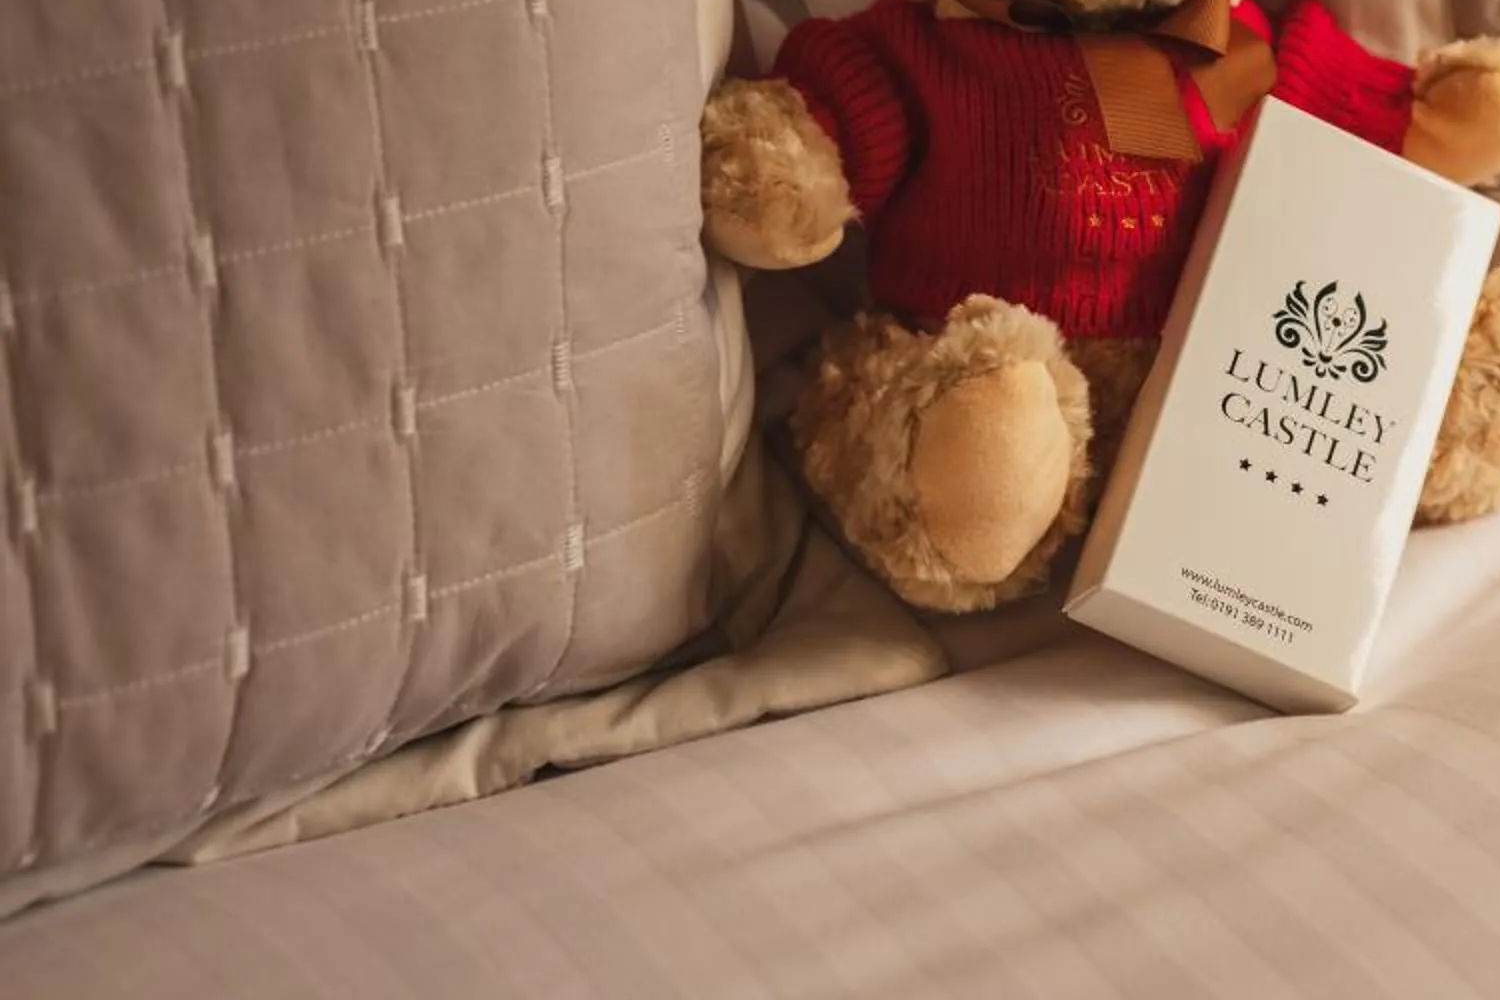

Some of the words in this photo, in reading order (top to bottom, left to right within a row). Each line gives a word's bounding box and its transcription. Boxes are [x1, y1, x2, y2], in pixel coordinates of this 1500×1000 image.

[1224, 348, 1397, 444] LUMLEY
[1220, 391, 1378, 483] CASTLE
[1181, 567, 1313, 632] www.lumleycastle.com
[1241, 611, 1265, 631] 389
[1267, 623, 1293, 644] 1111
